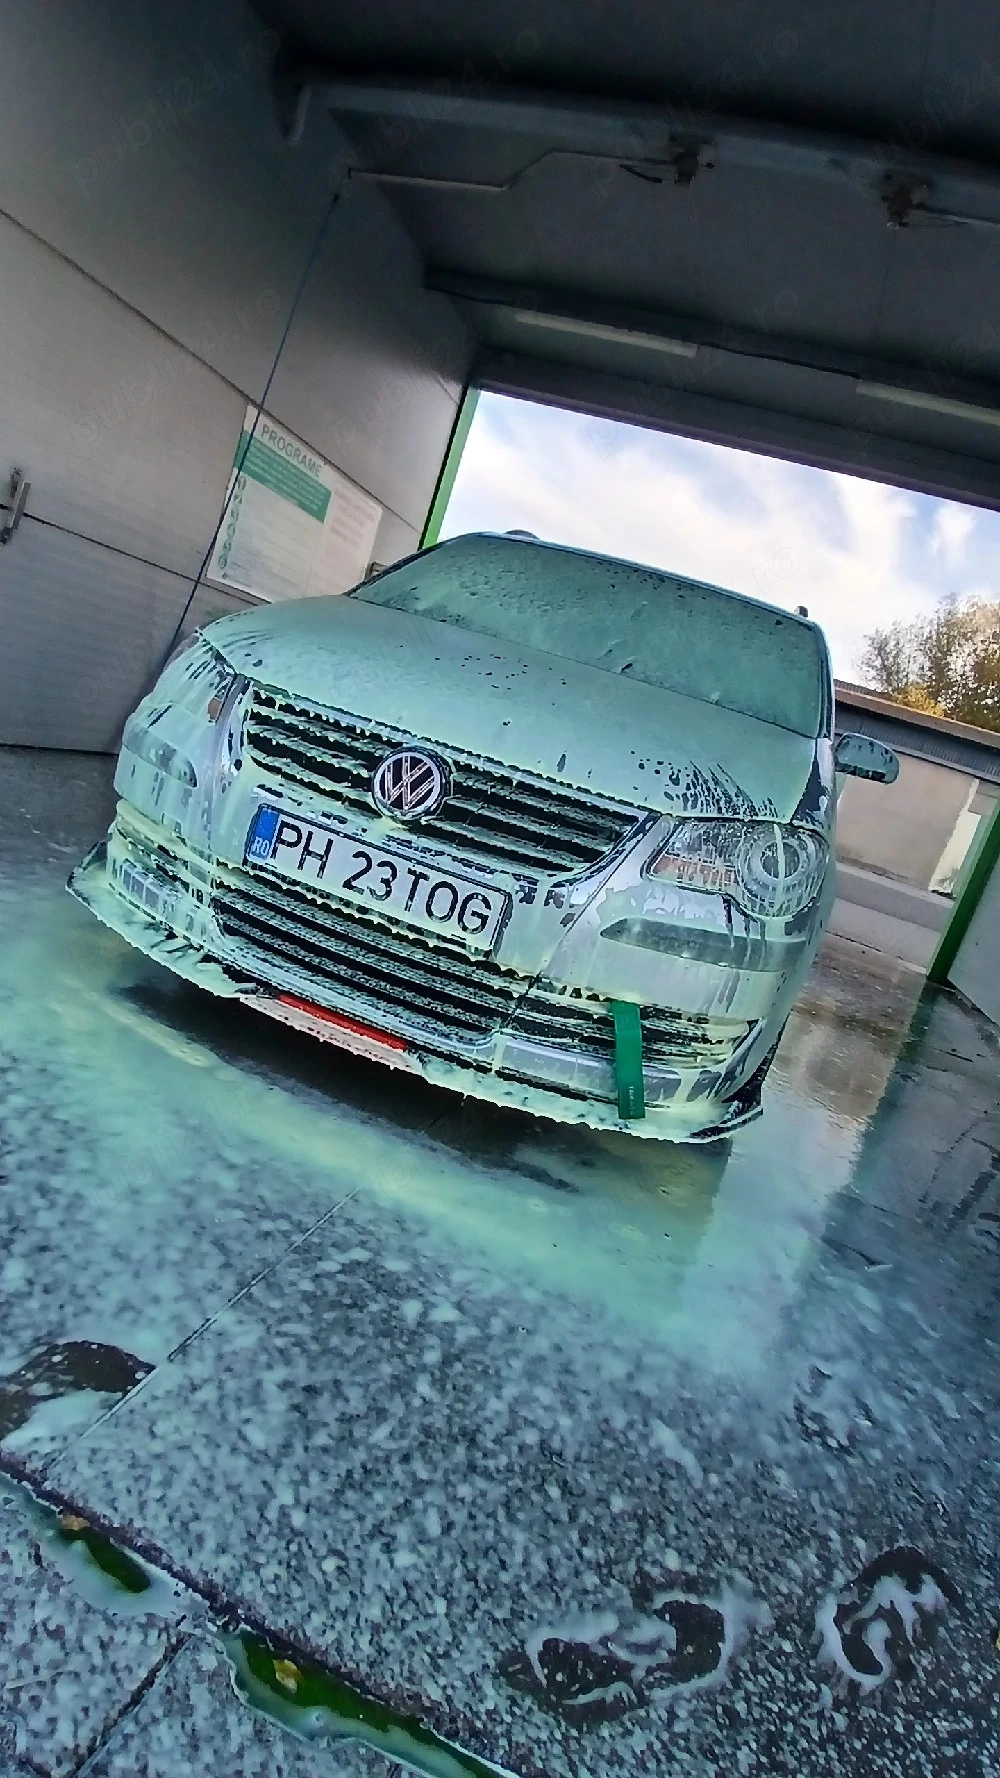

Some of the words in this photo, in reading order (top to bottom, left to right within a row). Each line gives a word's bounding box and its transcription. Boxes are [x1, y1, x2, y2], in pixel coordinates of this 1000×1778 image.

[260, 424, 322, 478] PROGRAME
[252, 836, 270, 856] RO
[269, 820, 333, 879] PH
